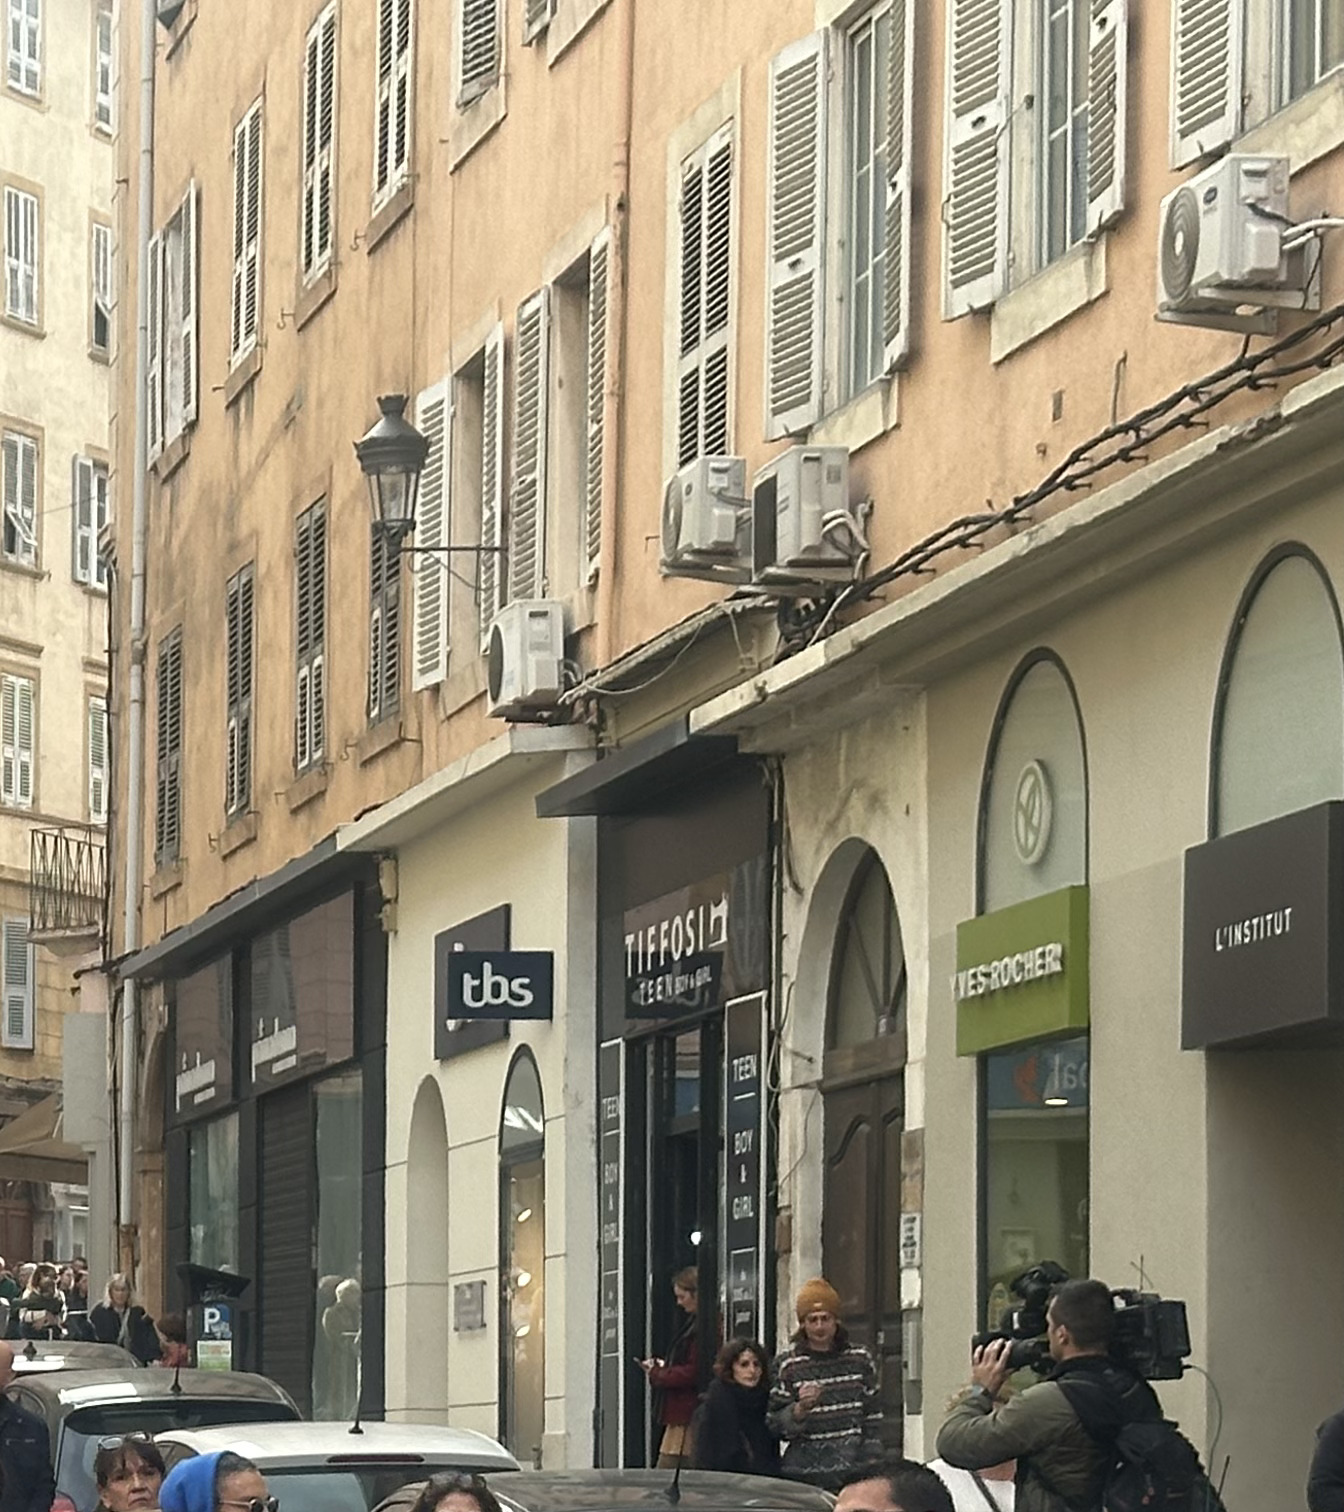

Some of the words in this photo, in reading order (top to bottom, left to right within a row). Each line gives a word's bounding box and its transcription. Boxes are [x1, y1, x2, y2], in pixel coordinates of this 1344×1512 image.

[625, 905, 704, 978] TIFFOSI
[1215, 907, 1292, 952] L'INSTITUT
[462, 961, 534, 1008] tbs
[732, 1053, 758, 1082] TEEN
[733, 1129, 754, 1156] BOY
